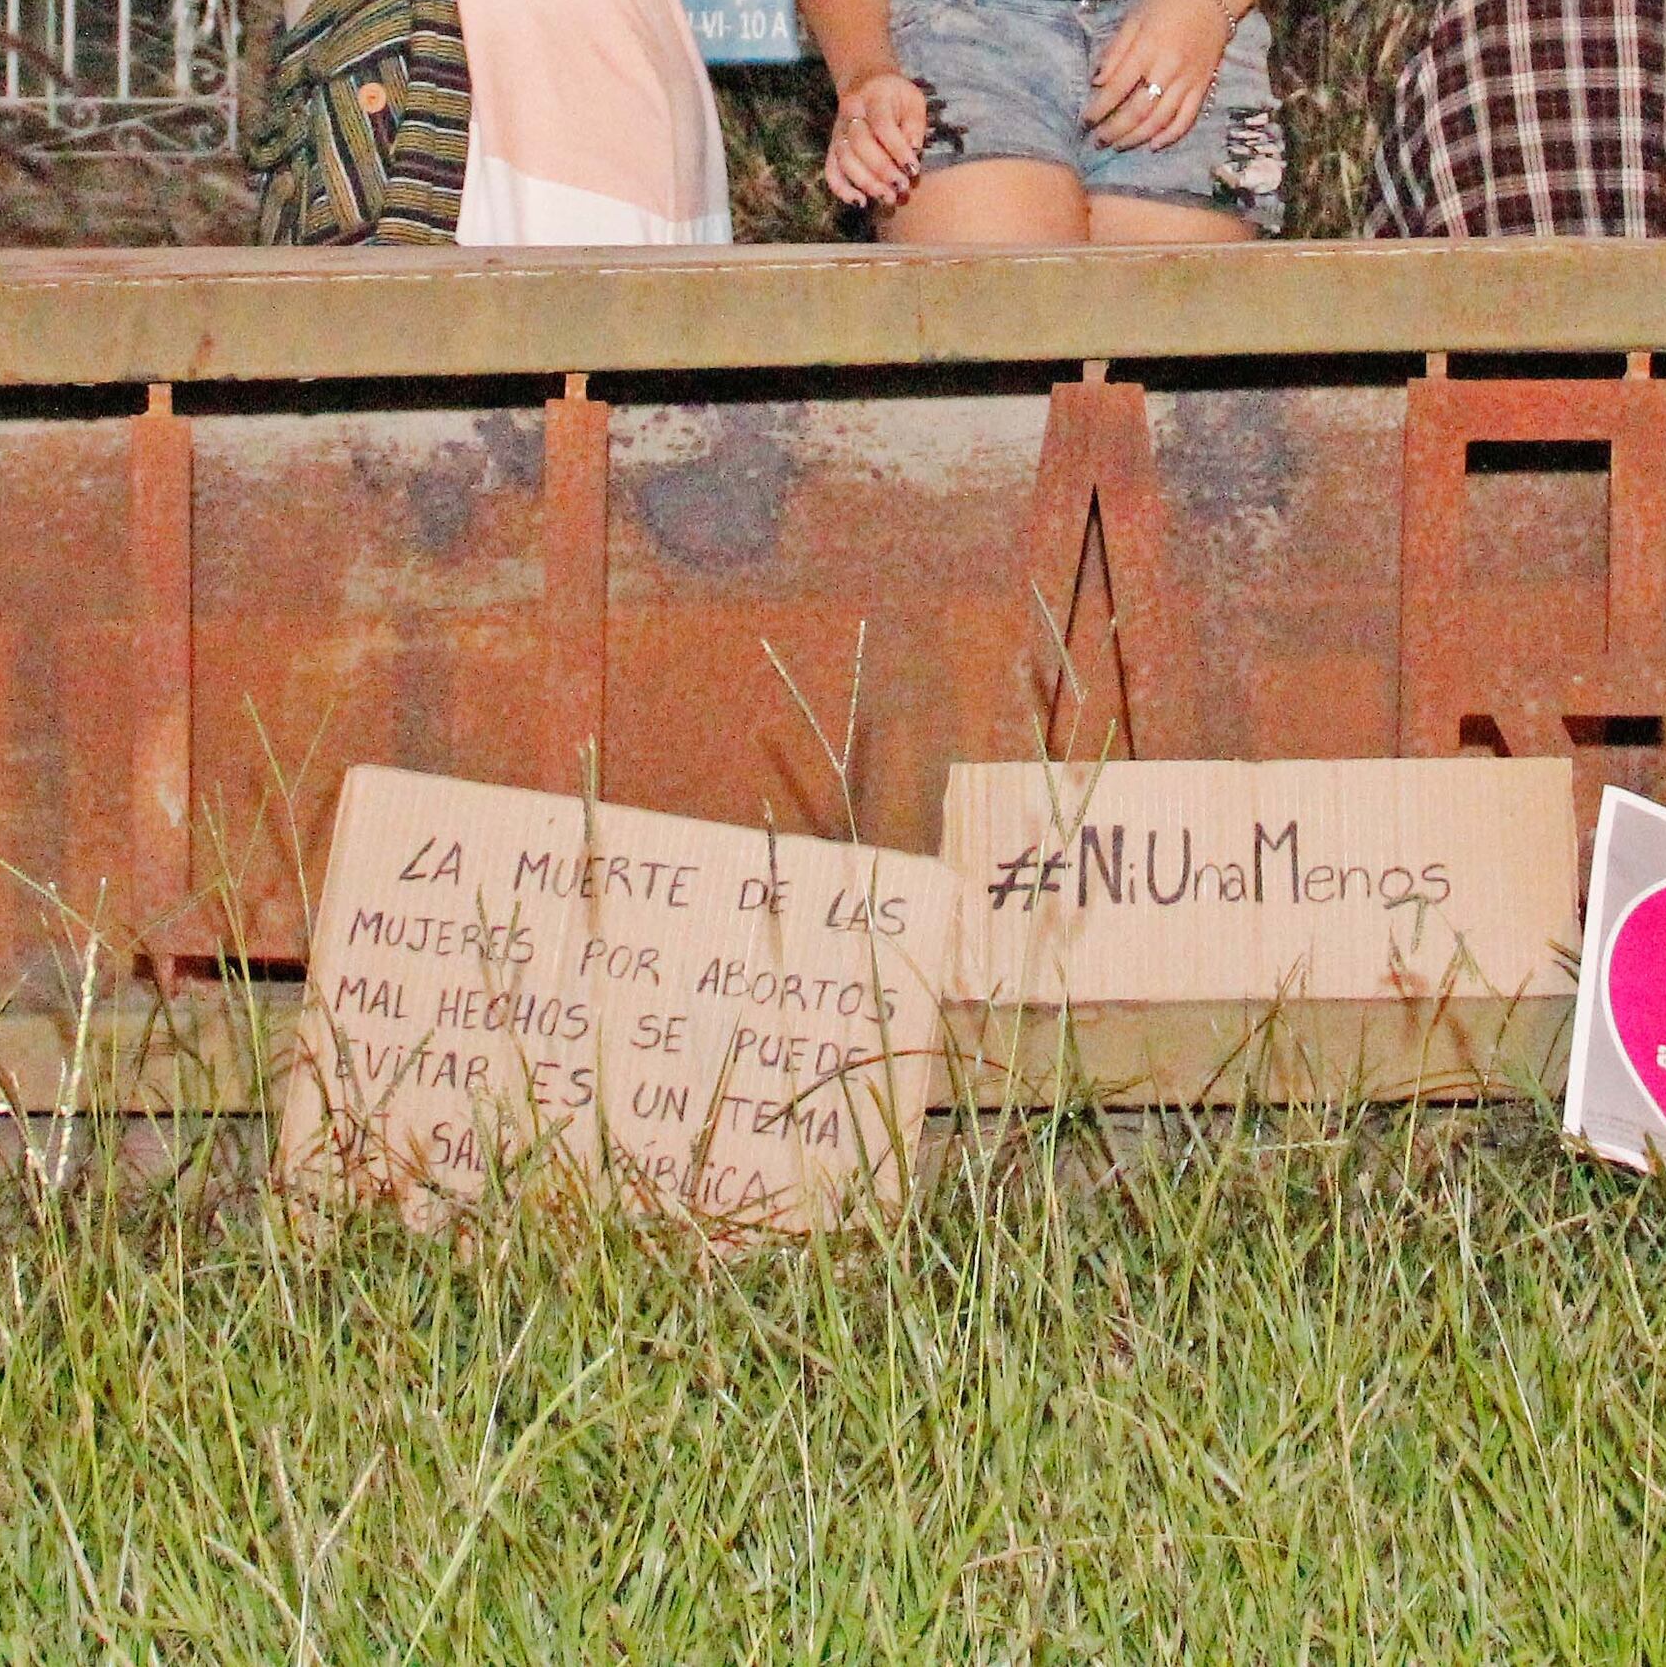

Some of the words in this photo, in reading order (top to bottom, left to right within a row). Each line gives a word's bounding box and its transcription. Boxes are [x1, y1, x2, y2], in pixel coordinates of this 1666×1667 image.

[399, 836, 463, 885] LA
[514, 850, 699, 908] MUERTE
[738, 877, 790, 914] DE
[826, 887, 907, 934] LAS
[987, 819, 1453, 911] #NiUnaMenos
[349, 907, 534, 963] MUJERES
[579, 937, 661, 986] POR
[697, 956, 900, 1025] ABORTOS
[334, 974, 409, 1020] MAL
[437, 986, 590, 1040] HECHOS
[630, 1013, 688, 1053] SE
[733, 1027, 869, 1082] PUEDE
[533, 1061, 593, 1108] ES
[632, 1081, 689, 1123] UN
[721, 1094, 840, 1149] TEMA
